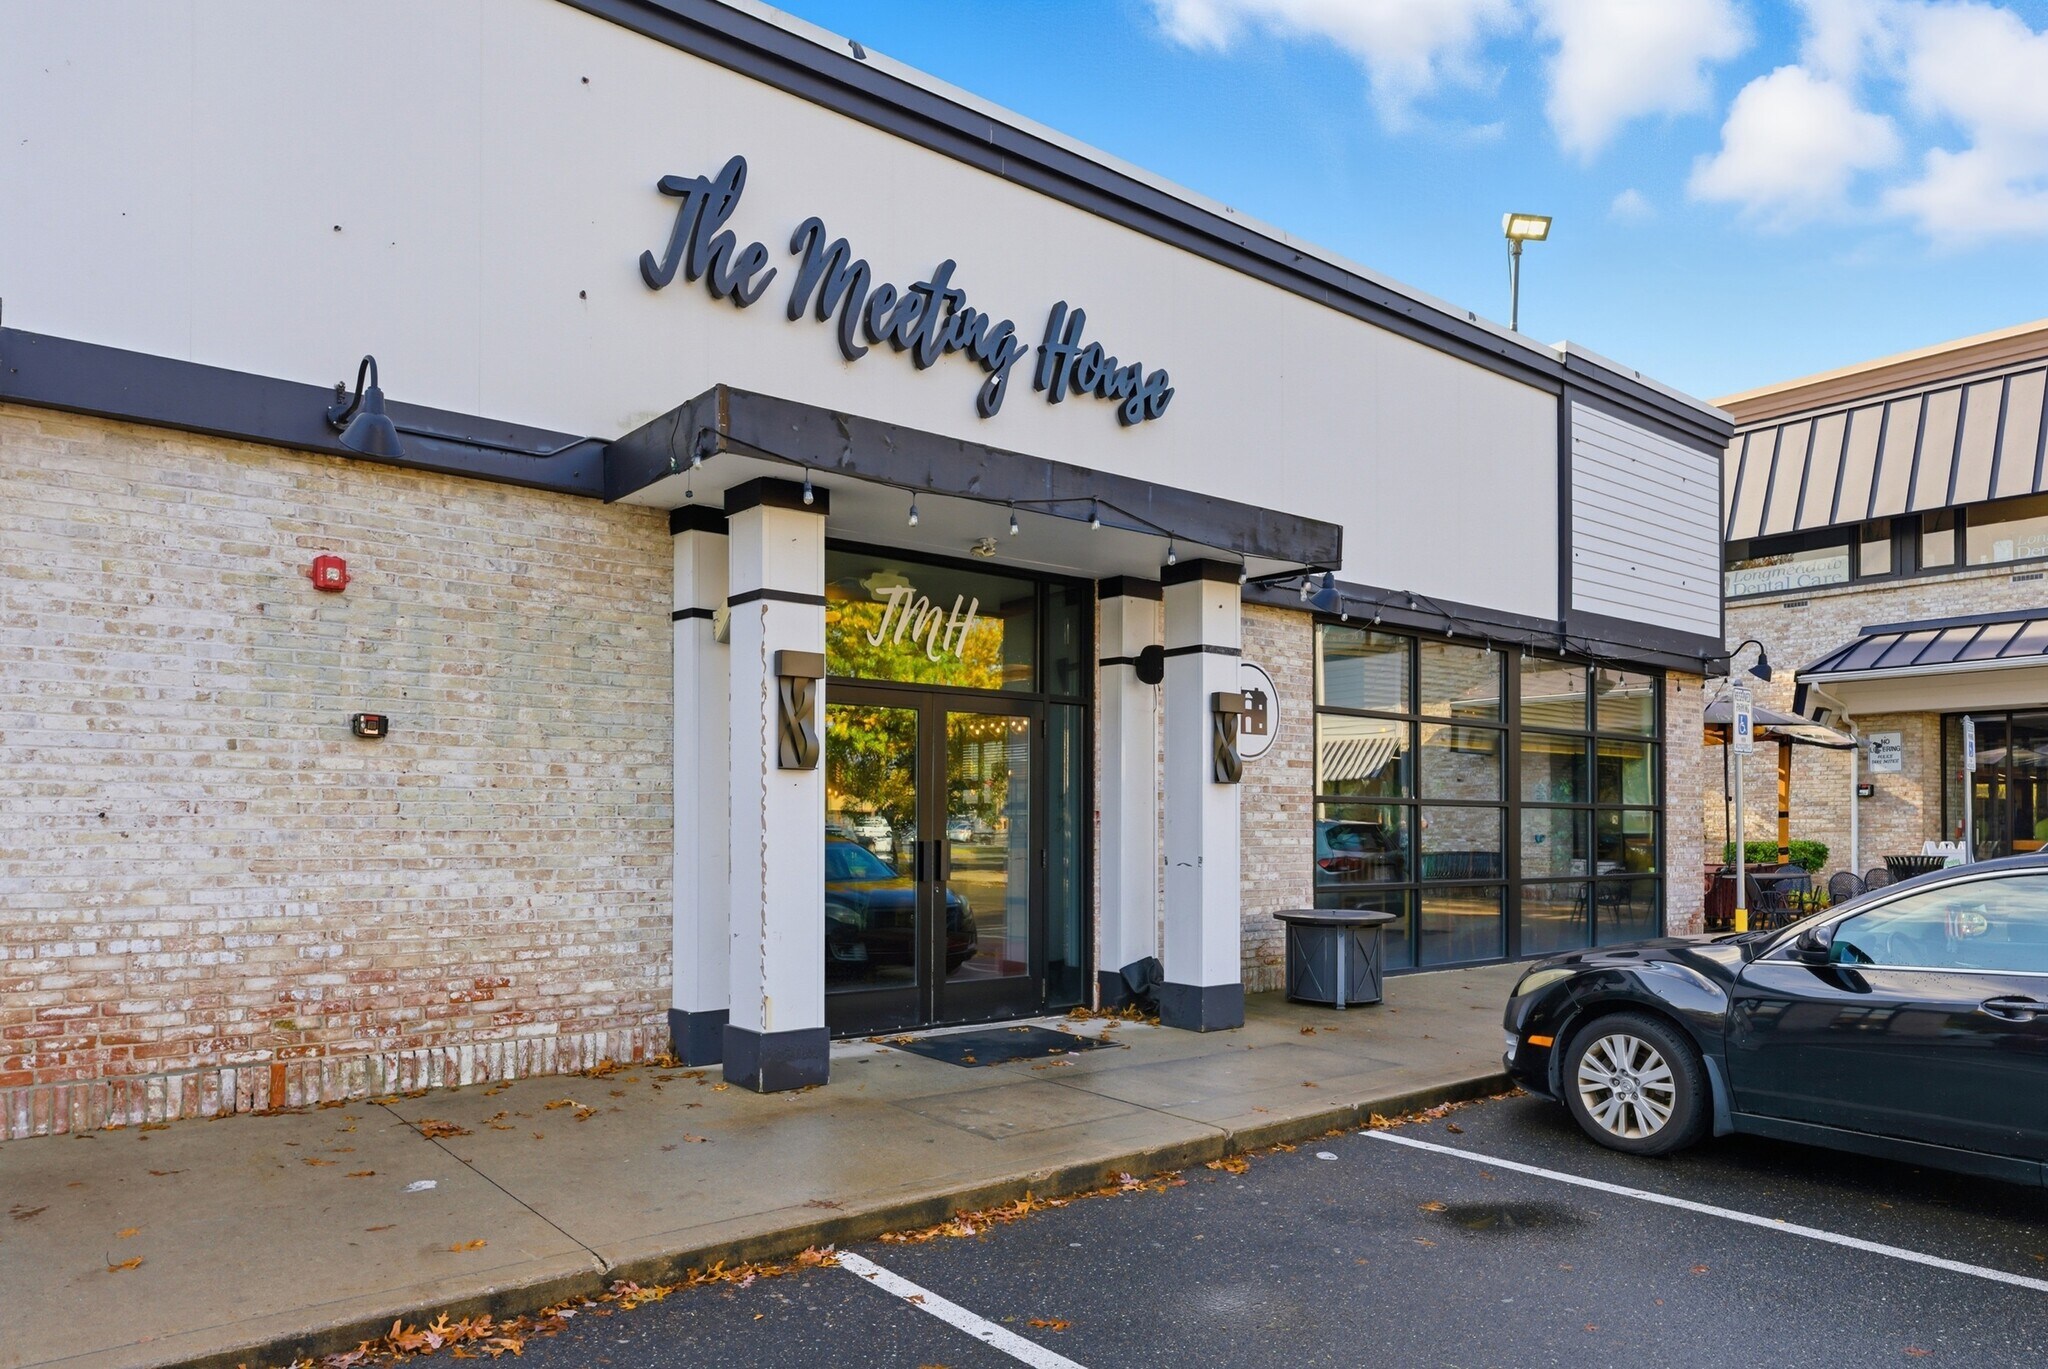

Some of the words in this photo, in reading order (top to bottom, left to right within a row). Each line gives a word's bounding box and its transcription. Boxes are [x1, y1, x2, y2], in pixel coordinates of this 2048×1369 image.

[640, 155, 777, 308] The
[787, 216, 1029, 419] Meeting
[1034, 300, 1175, 427] House
[1734, 559, 1842, 582] Longmeadow
[1733, 576, 1790, 595] Dental
[1797, 573, 1842, 587] Care
